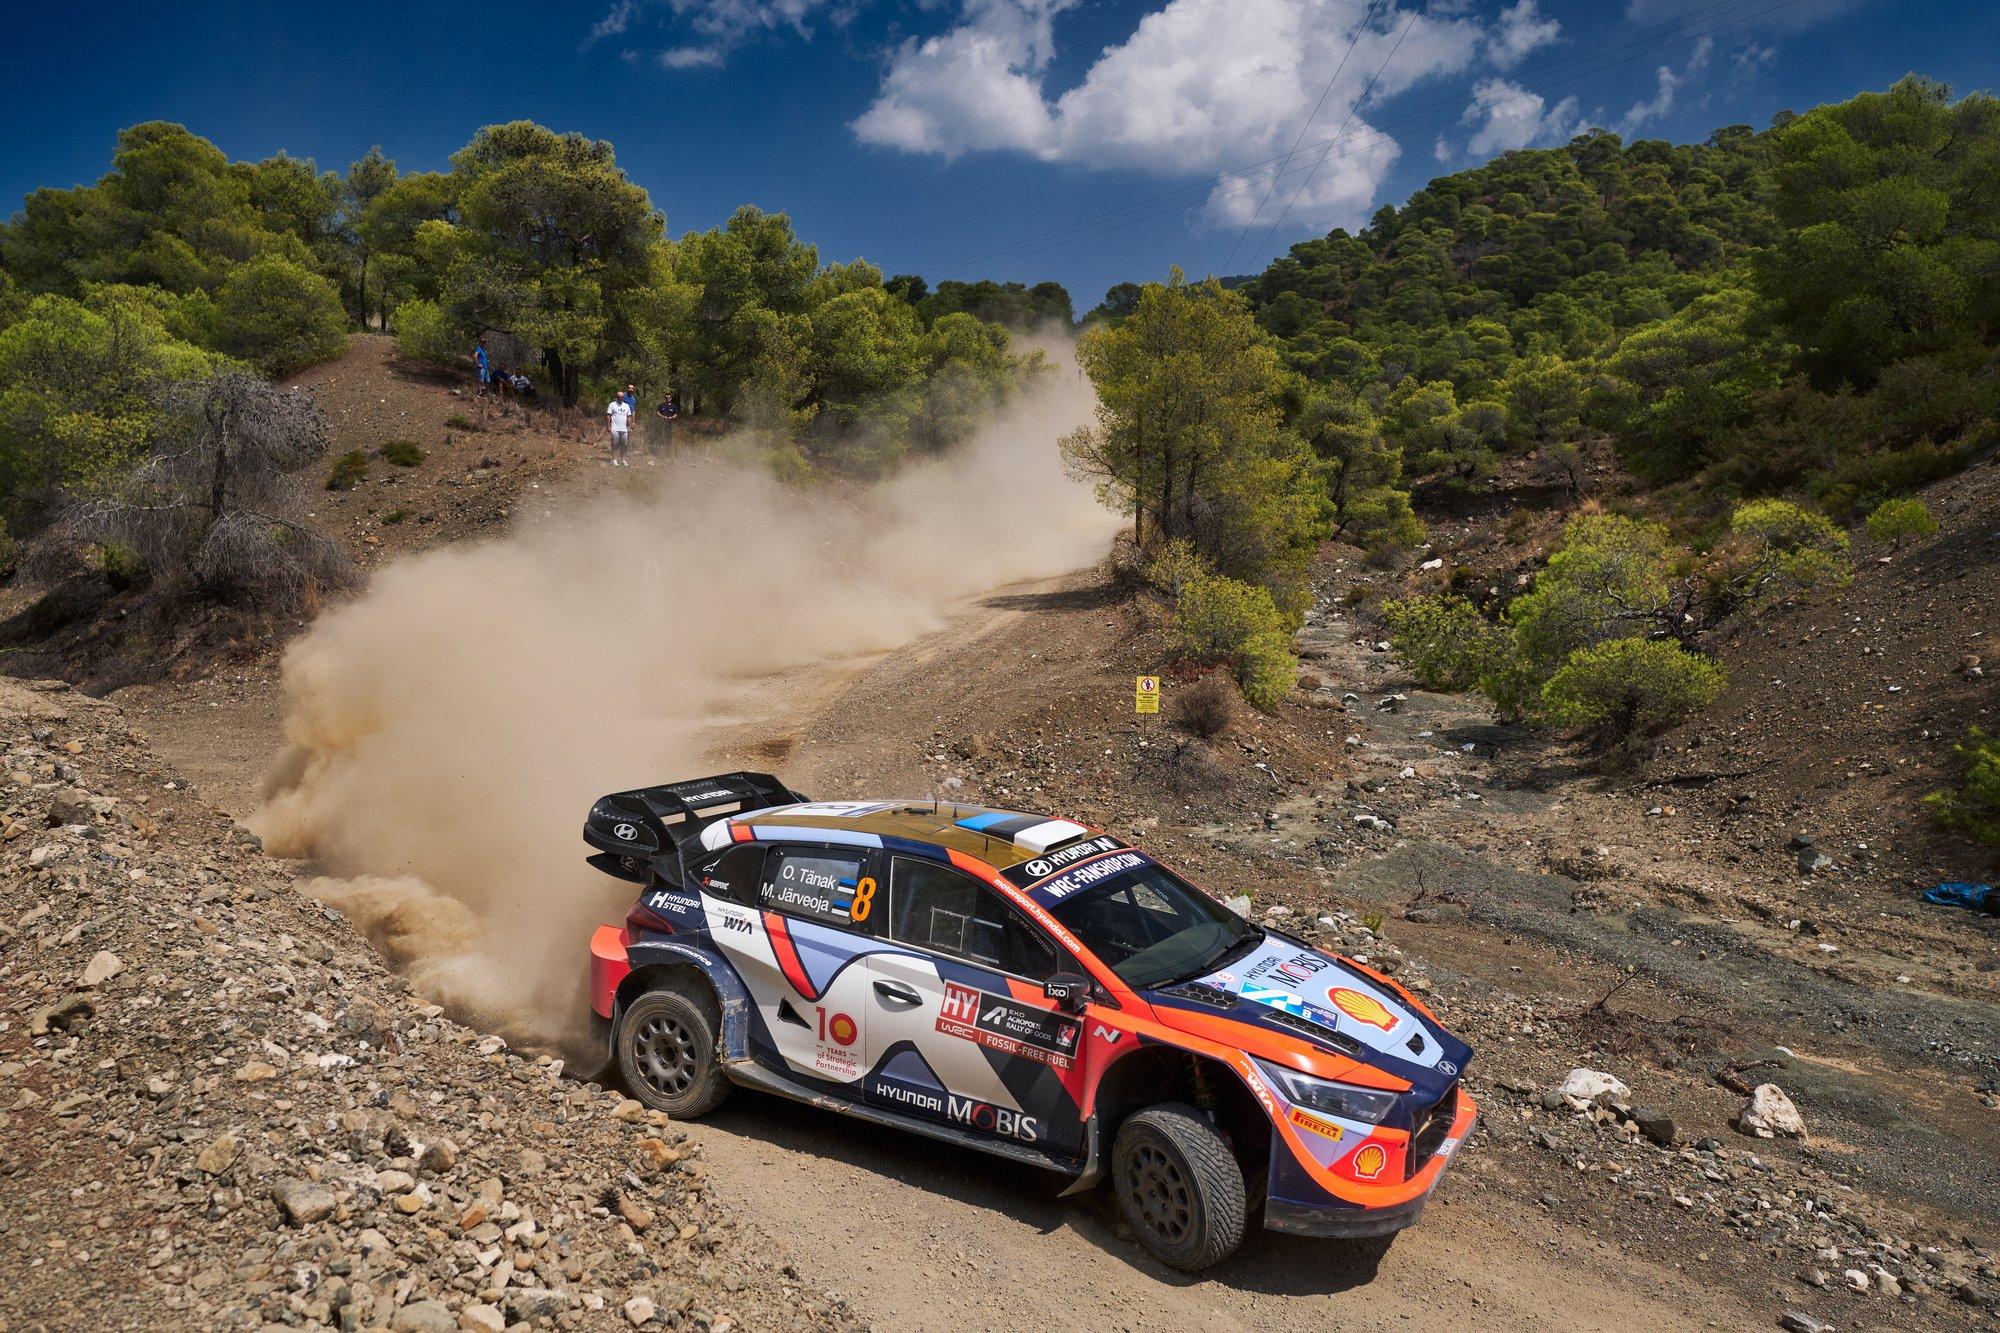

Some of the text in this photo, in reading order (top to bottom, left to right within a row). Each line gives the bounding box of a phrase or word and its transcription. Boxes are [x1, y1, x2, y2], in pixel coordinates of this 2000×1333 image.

[682, 789, 734, 804] HYUNDAI
[1047, 842, 1099, 866] HYUNDAI
[782, 865, 836, 890] O. Tänak
[1043, 853, 1145, 898] WRC-FANSHOP.COM
[662, 902, 686, 914] STEEL
[667, 894, 701, 909] HYUNDAI
[761, 882, 829, 913] M. Järveoja
[850, 876, 877, 922] 8
[717, 907, 745, 917] HYUNDAI
[993, 878, 1081, 953] motorsport.hyundai.com
[1243, 955, 1282, 980] HYUNDAI
[1266, 953, 1328, 989] MOBIS
[942, 987, 977, 1019] HY
[1006, 1022, 1024, 1032] RALLY
[1034, 1030, 1051, 1040] GODS
[1007, 1016, 1041, 1031] ACROPOLIS
[827, 1047, 847, 1057] YEARS
[941, 1021, 974, 1039] WRC
[1047, 1053, 1070, 1069] FUEL
[815, 1060, 857, 1076] Partnership
[826, 1053, 857, 1068] Strategic
[876, 1083, 1037, 1142] HYUNDAI MOBIS
[1293, 1111, 1339, 1138] PIRELLI
